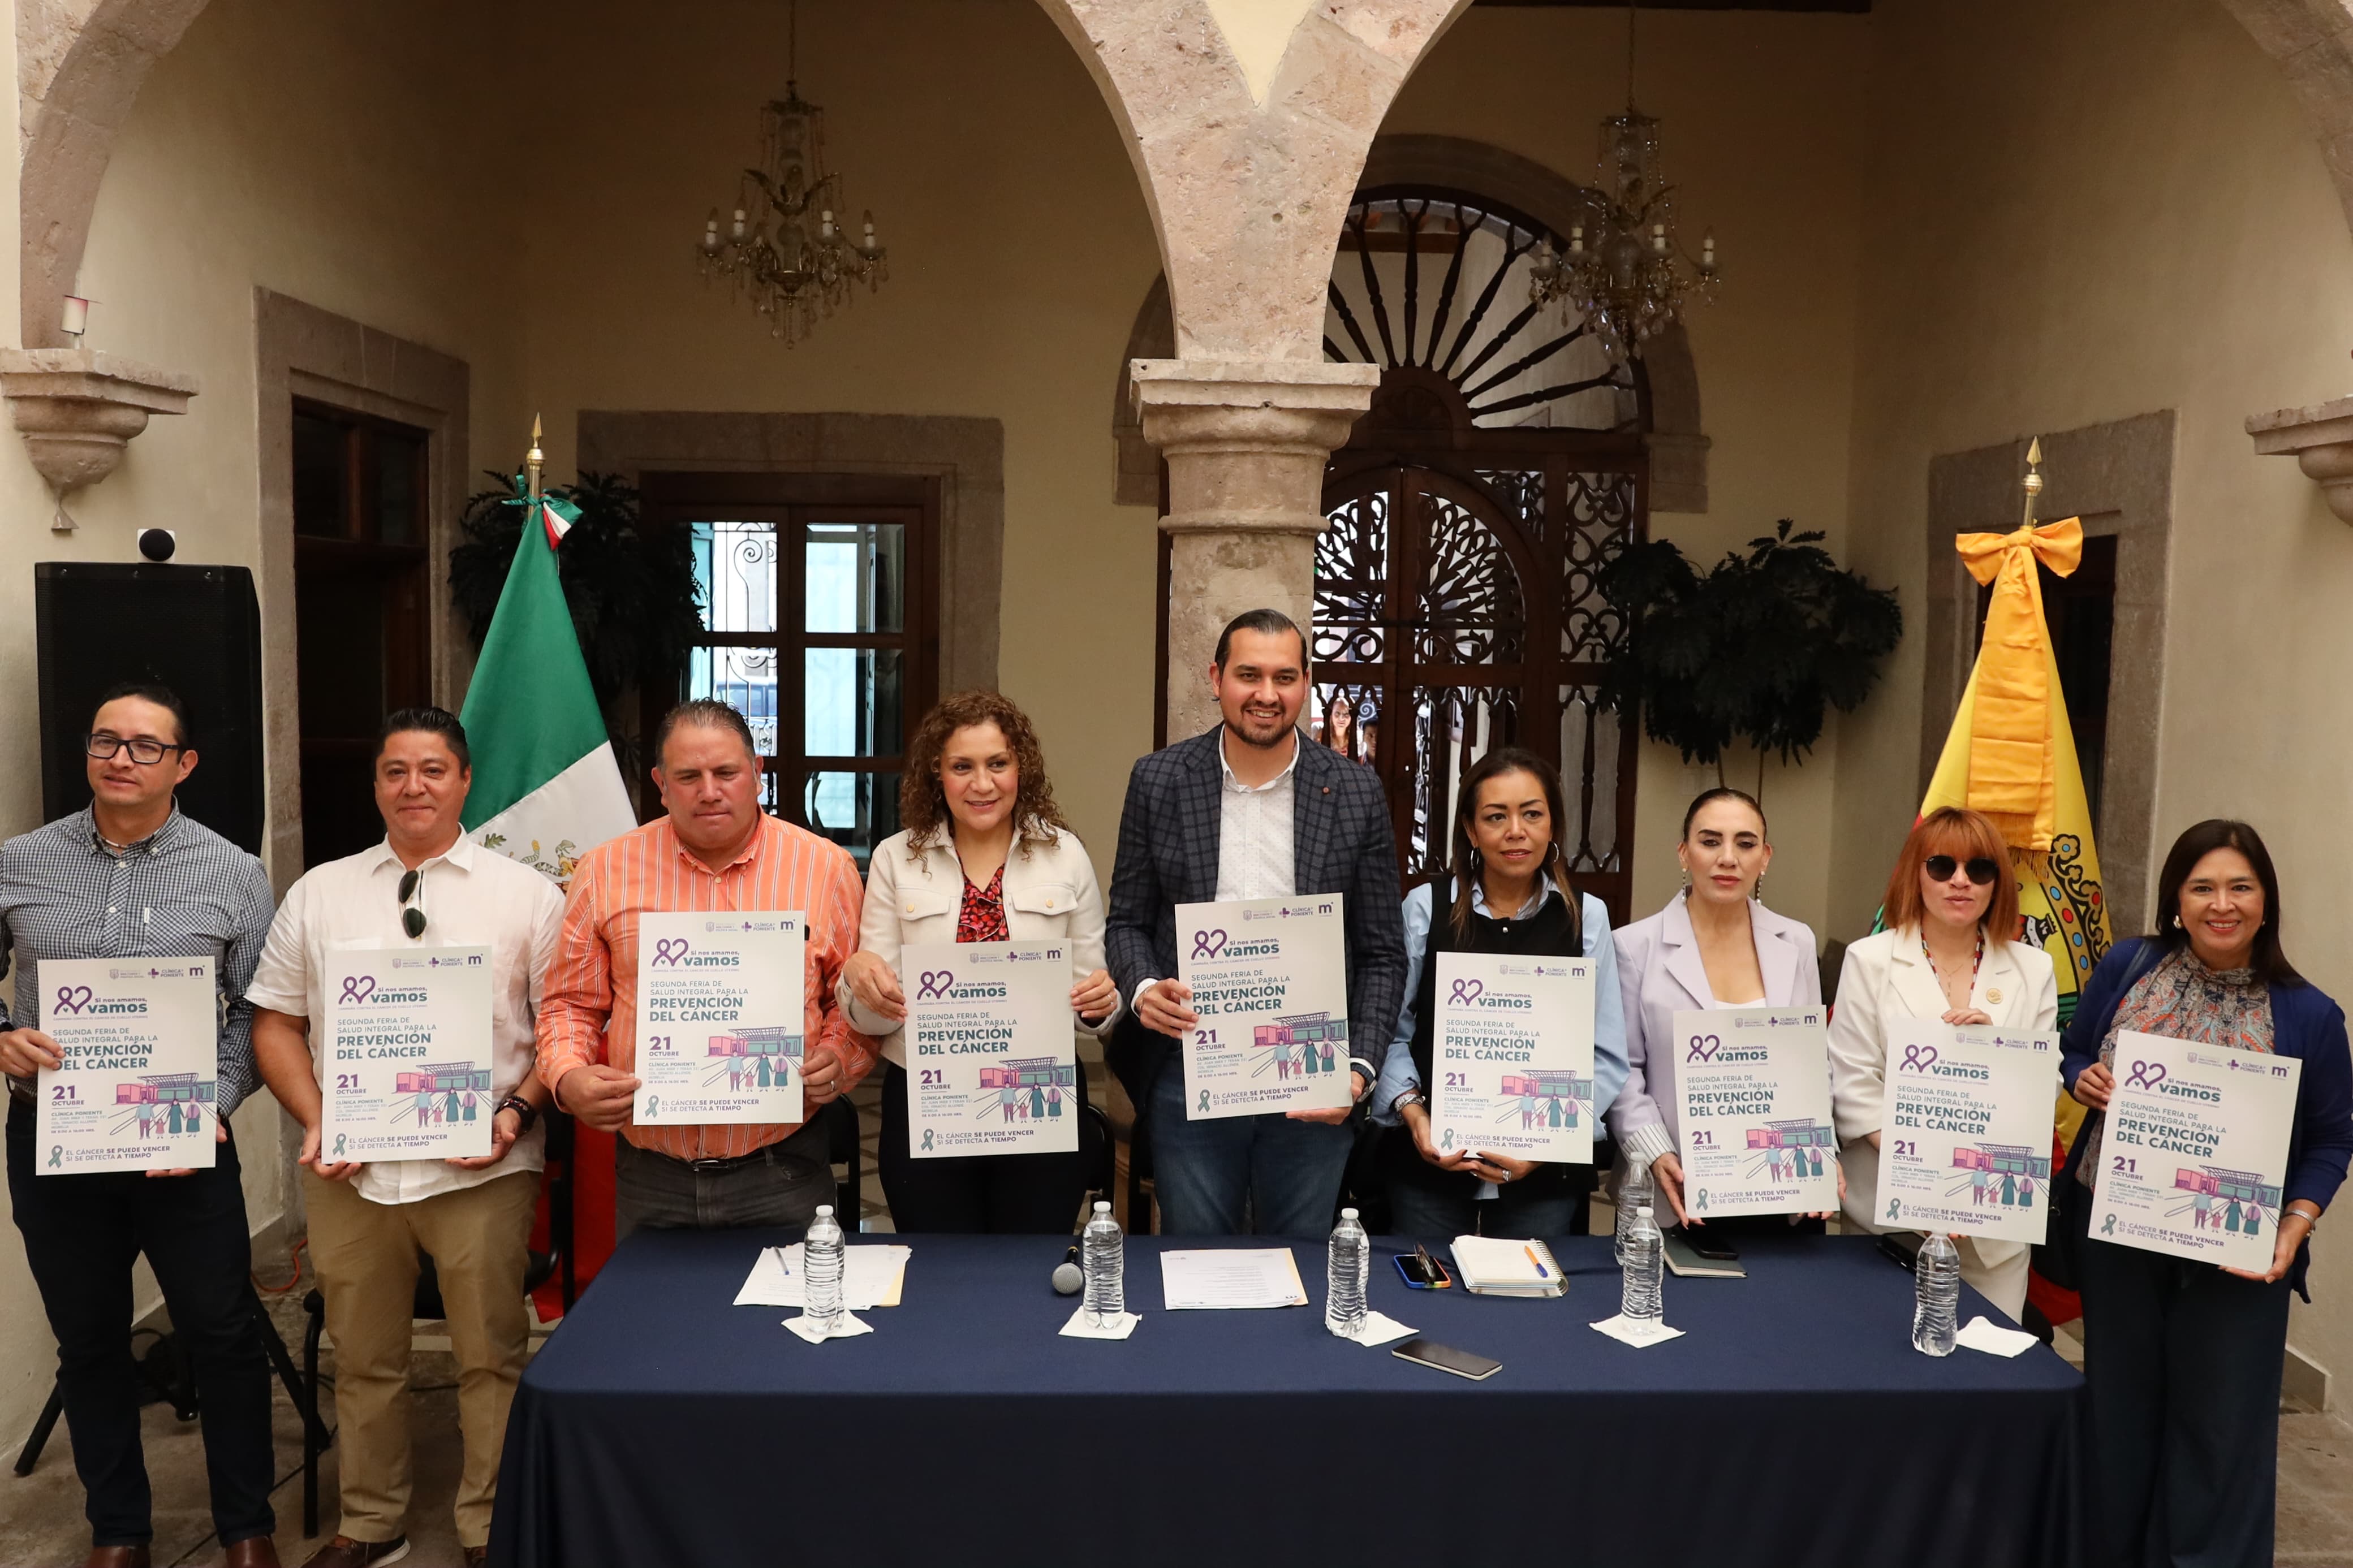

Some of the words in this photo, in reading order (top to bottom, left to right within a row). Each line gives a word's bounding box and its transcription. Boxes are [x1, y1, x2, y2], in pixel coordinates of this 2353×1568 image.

[1222, 944, 1279, 957] vamos
[683, 957, 739, 966] vamos
[1191, 973, 1229, 981] SEGUNDA
[1219, 978, 1256, 987] INTEGRAL
[370, 992, 427, 1003] vamos
[949, 987, 1007, 999] vamos
[1192, 982, 1285, 1003] PREVENCIÓN
[87, 1003, 148, 1014] vamos
[650, 994, 743, 1008] PREVENCIÓN
[1193, 1004, 1219, 1016] DEL
[1223, 996, 1282, 1013] CÁNCER
[1477, 997, 1532, 1008] vamos
[650, 1011, 675, 1022] DEL
[680, 1006, 738, 1021] CÁNCER
[337, 1030, 431, 1047] PREVENCIÓN
[918, 1025, 1012, 1042] PREVENCIÓN
[1195, 1029, 1216, 1045] 21
[63, 1040, 152, 1057] REVENCIÓN
[649, 1036, 670, 1050] 21
[919, 1044, 945, 1055] DEL
[949, 1038, 1009, 1054] CÁNCER
[1446, 1035, 1535, 1049] PREVENCIÓN
[337, 1049, 363, 1060] DEL
[368, 1043, 426, 1059] CÁNCER
[1445, 1048, 1469, 1059] DEL
[1475, 1045, 1531, 1062] CÁNCER
[1716, 1051, 1768, 1061] vamos
[85, 1053, 148, 1069] CÁNCER
[920, 1069, 941, 1084] 21
[1445, 1072, 1465, 1086] 21
[1932, 1065, 1989, 1079] vamos
[337, 1074, 357, 1088] 21
[52, 1085, 75, 1100] 21
[1688, 1087, 1774, 1104] PREVENCIÓN
[1897, 1085, 1934, 1095] SEGUNDA
[2159, 1083, 2220, 1102] vamos
[1897, 1093, 1921, 1102] SALUD
[1924, 1096, 1961, 1106] INTEGRAL
[1690, 1106, 1713, 1117] DEL
[1717, 1100, 1771, 1116] CÁNCER
[1896, 1102, 1990, 1122] PREVENCIÓN
[2121, 1101, 2160, 1113] SEGUNDA
[2162, 1108, 2185, 1118] FERIA
[1895, 1115, 1921, 1128] DEL
[1926, 1115, 1985, 1135] CÁNCER
[2119, 1109, 2146, 1119] SALUD
[2148, 1114, 2188, 1127] INTEGRAL
[2191, 1122, 2213, 1131] PARA
[1692, 1130, 1712, 1144] 21
[2118, 1118, 2220, 1146] PREVENCIÓN
[1894, 1140, 1915, 1155] 21
[2116, 1131, 2143, 1145] DEL
[2149, 1134, 2213, 1158] CÁNCER
[2113, 1156, 2136, 1173] 21
[2111, 1170, 2143, 1181] OCTUBRE
